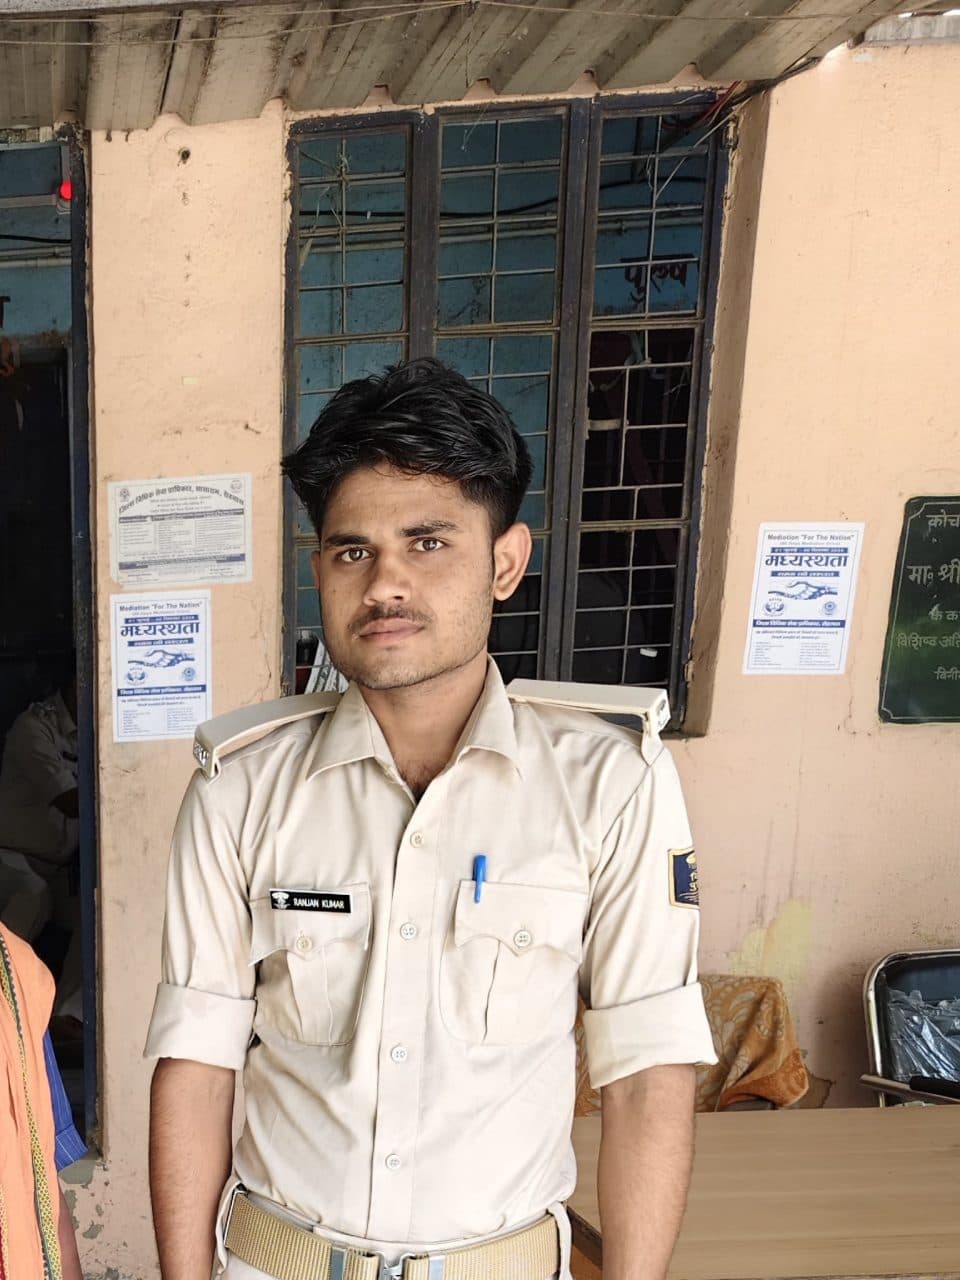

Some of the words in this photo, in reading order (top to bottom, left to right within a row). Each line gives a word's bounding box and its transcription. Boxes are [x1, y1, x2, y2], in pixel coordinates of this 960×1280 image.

[765, 555, 849, 568] मध्यस्थता
[120, 622, 200, 637] मध्यस्थता
[321, 900, 345, 909] KUMAR
